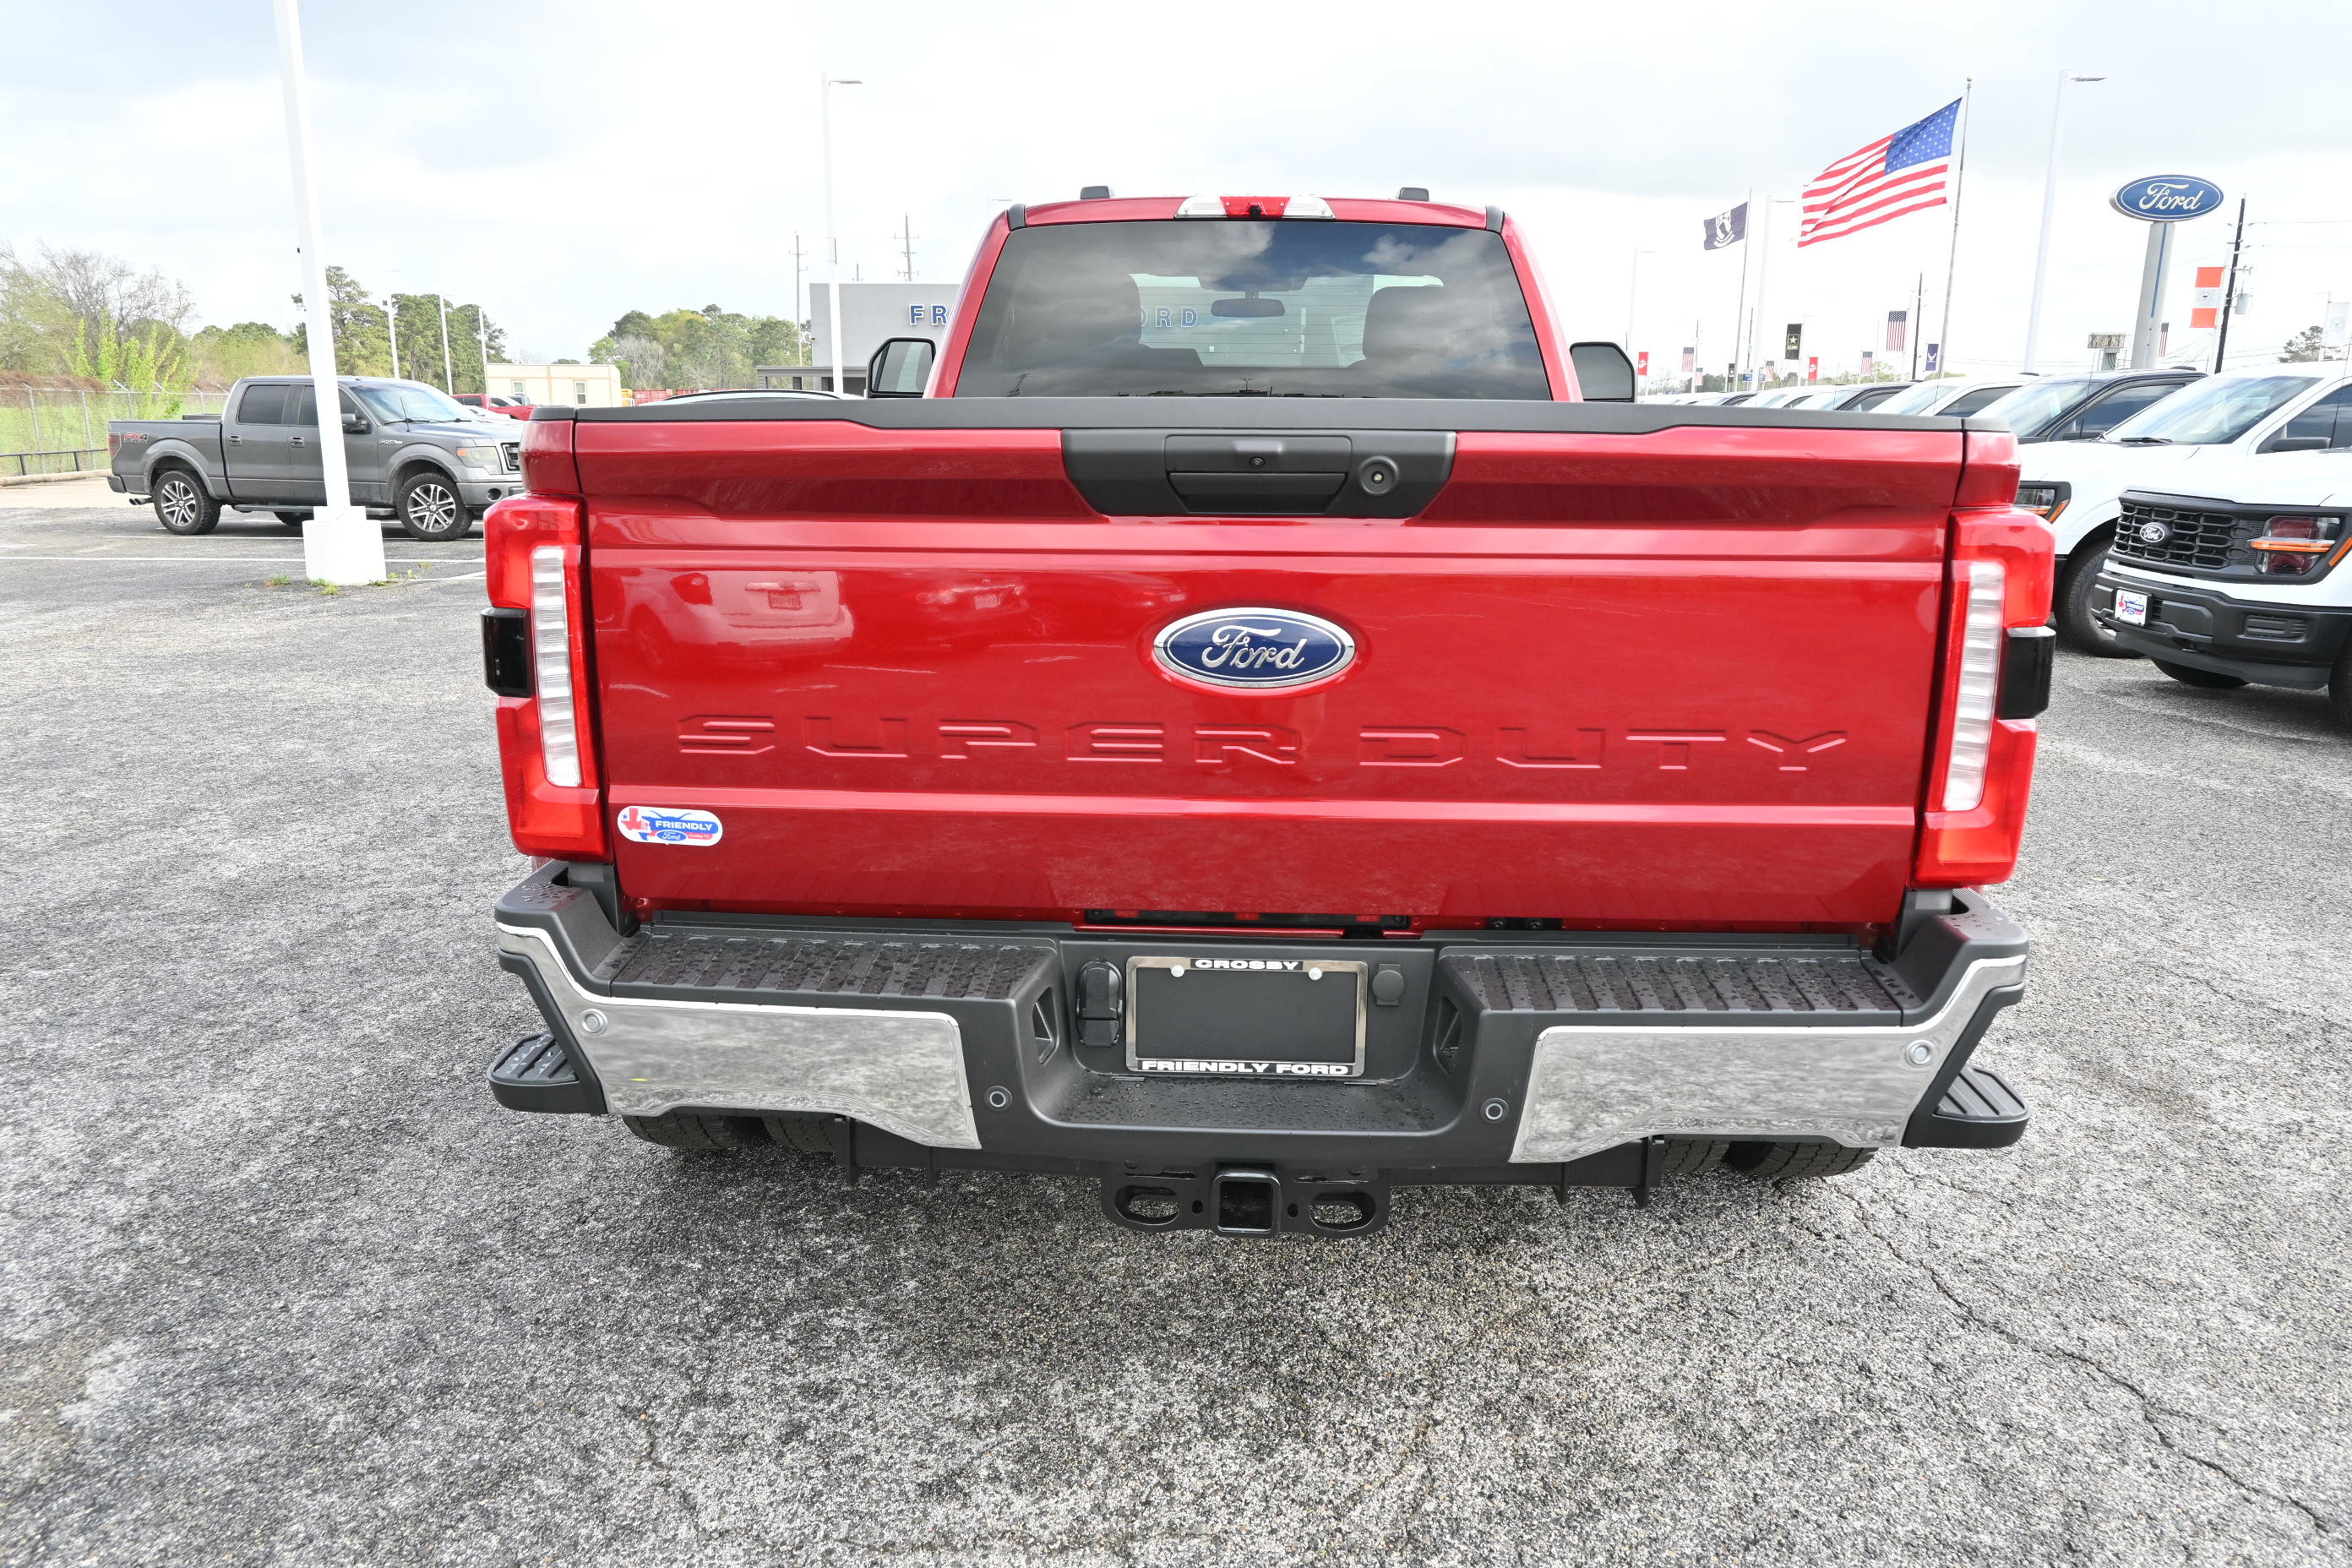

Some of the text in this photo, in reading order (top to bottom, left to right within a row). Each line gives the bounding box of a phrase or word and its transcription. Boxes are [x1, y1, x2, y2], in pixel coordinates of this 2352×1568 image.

[2138, 182, 2205, 210] Ford
[123, 433, 149, 442] FX4
[2143, 526, 2160, 540] Ford
[1201, 625, 1308, 669] Ford
[678, 715, 1847, 771] SUPER DUTY
[656, 820, 712, 831] FRIENDLY
[662, 831, 680, 841] Ford
[1195, 959, 1299, 971] CROSBY
[1141, 1060, 1348, 1075] FRIENDLY FORD
